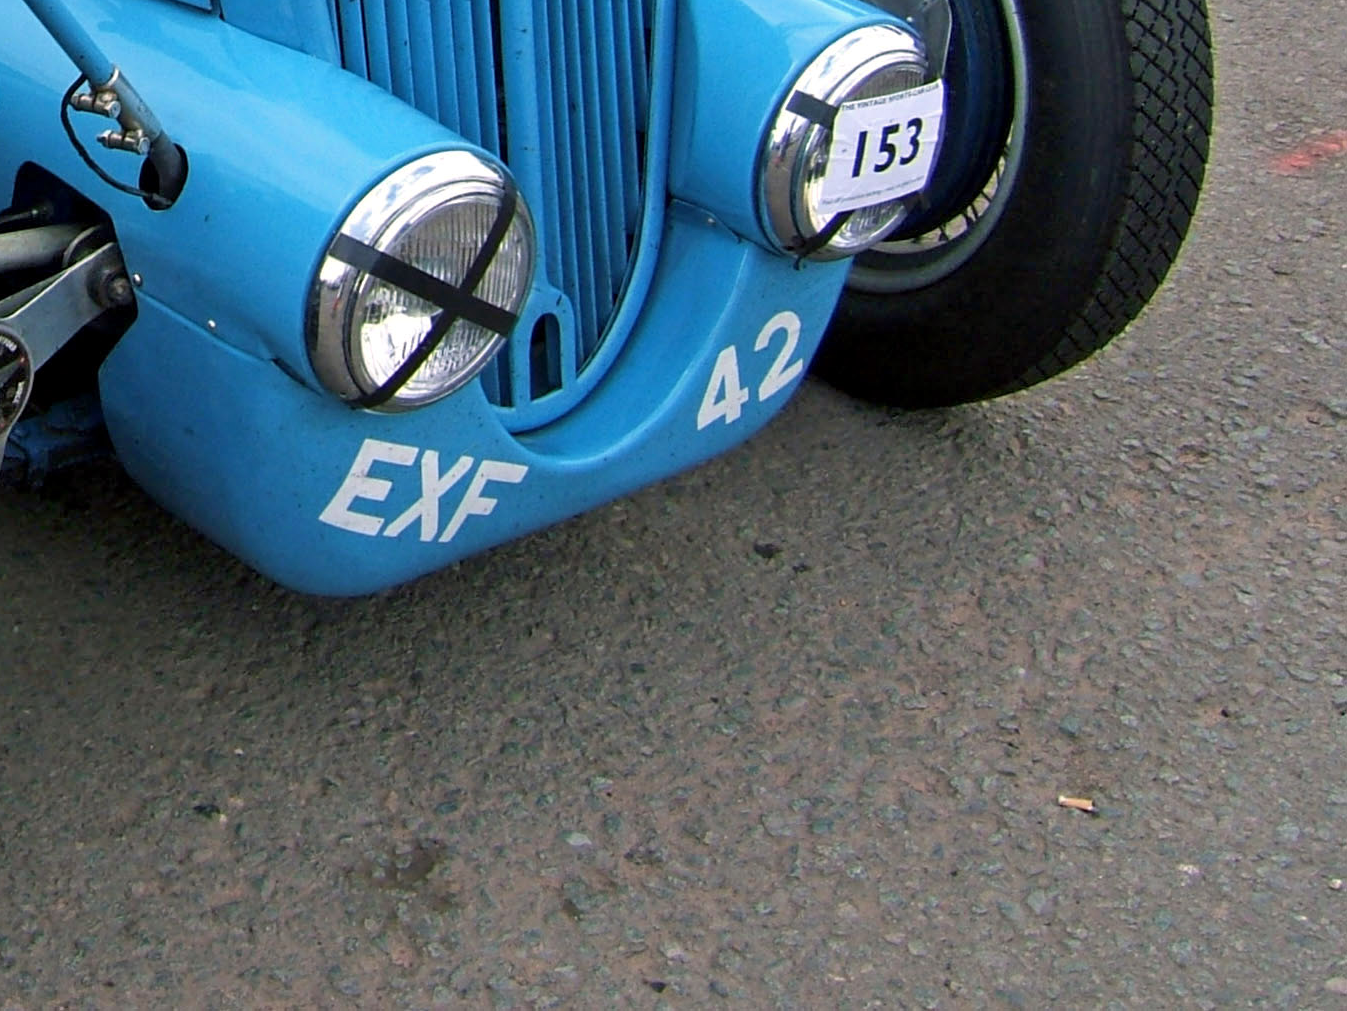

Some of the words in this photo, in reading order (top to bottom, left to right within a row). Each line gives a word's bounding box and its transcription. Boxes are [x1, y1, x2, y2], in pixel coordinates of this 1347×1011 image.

[852, 117, 923, 178] 153
[319, 438, 529, 543] EXF
[697, 310, 803, 431] 42
